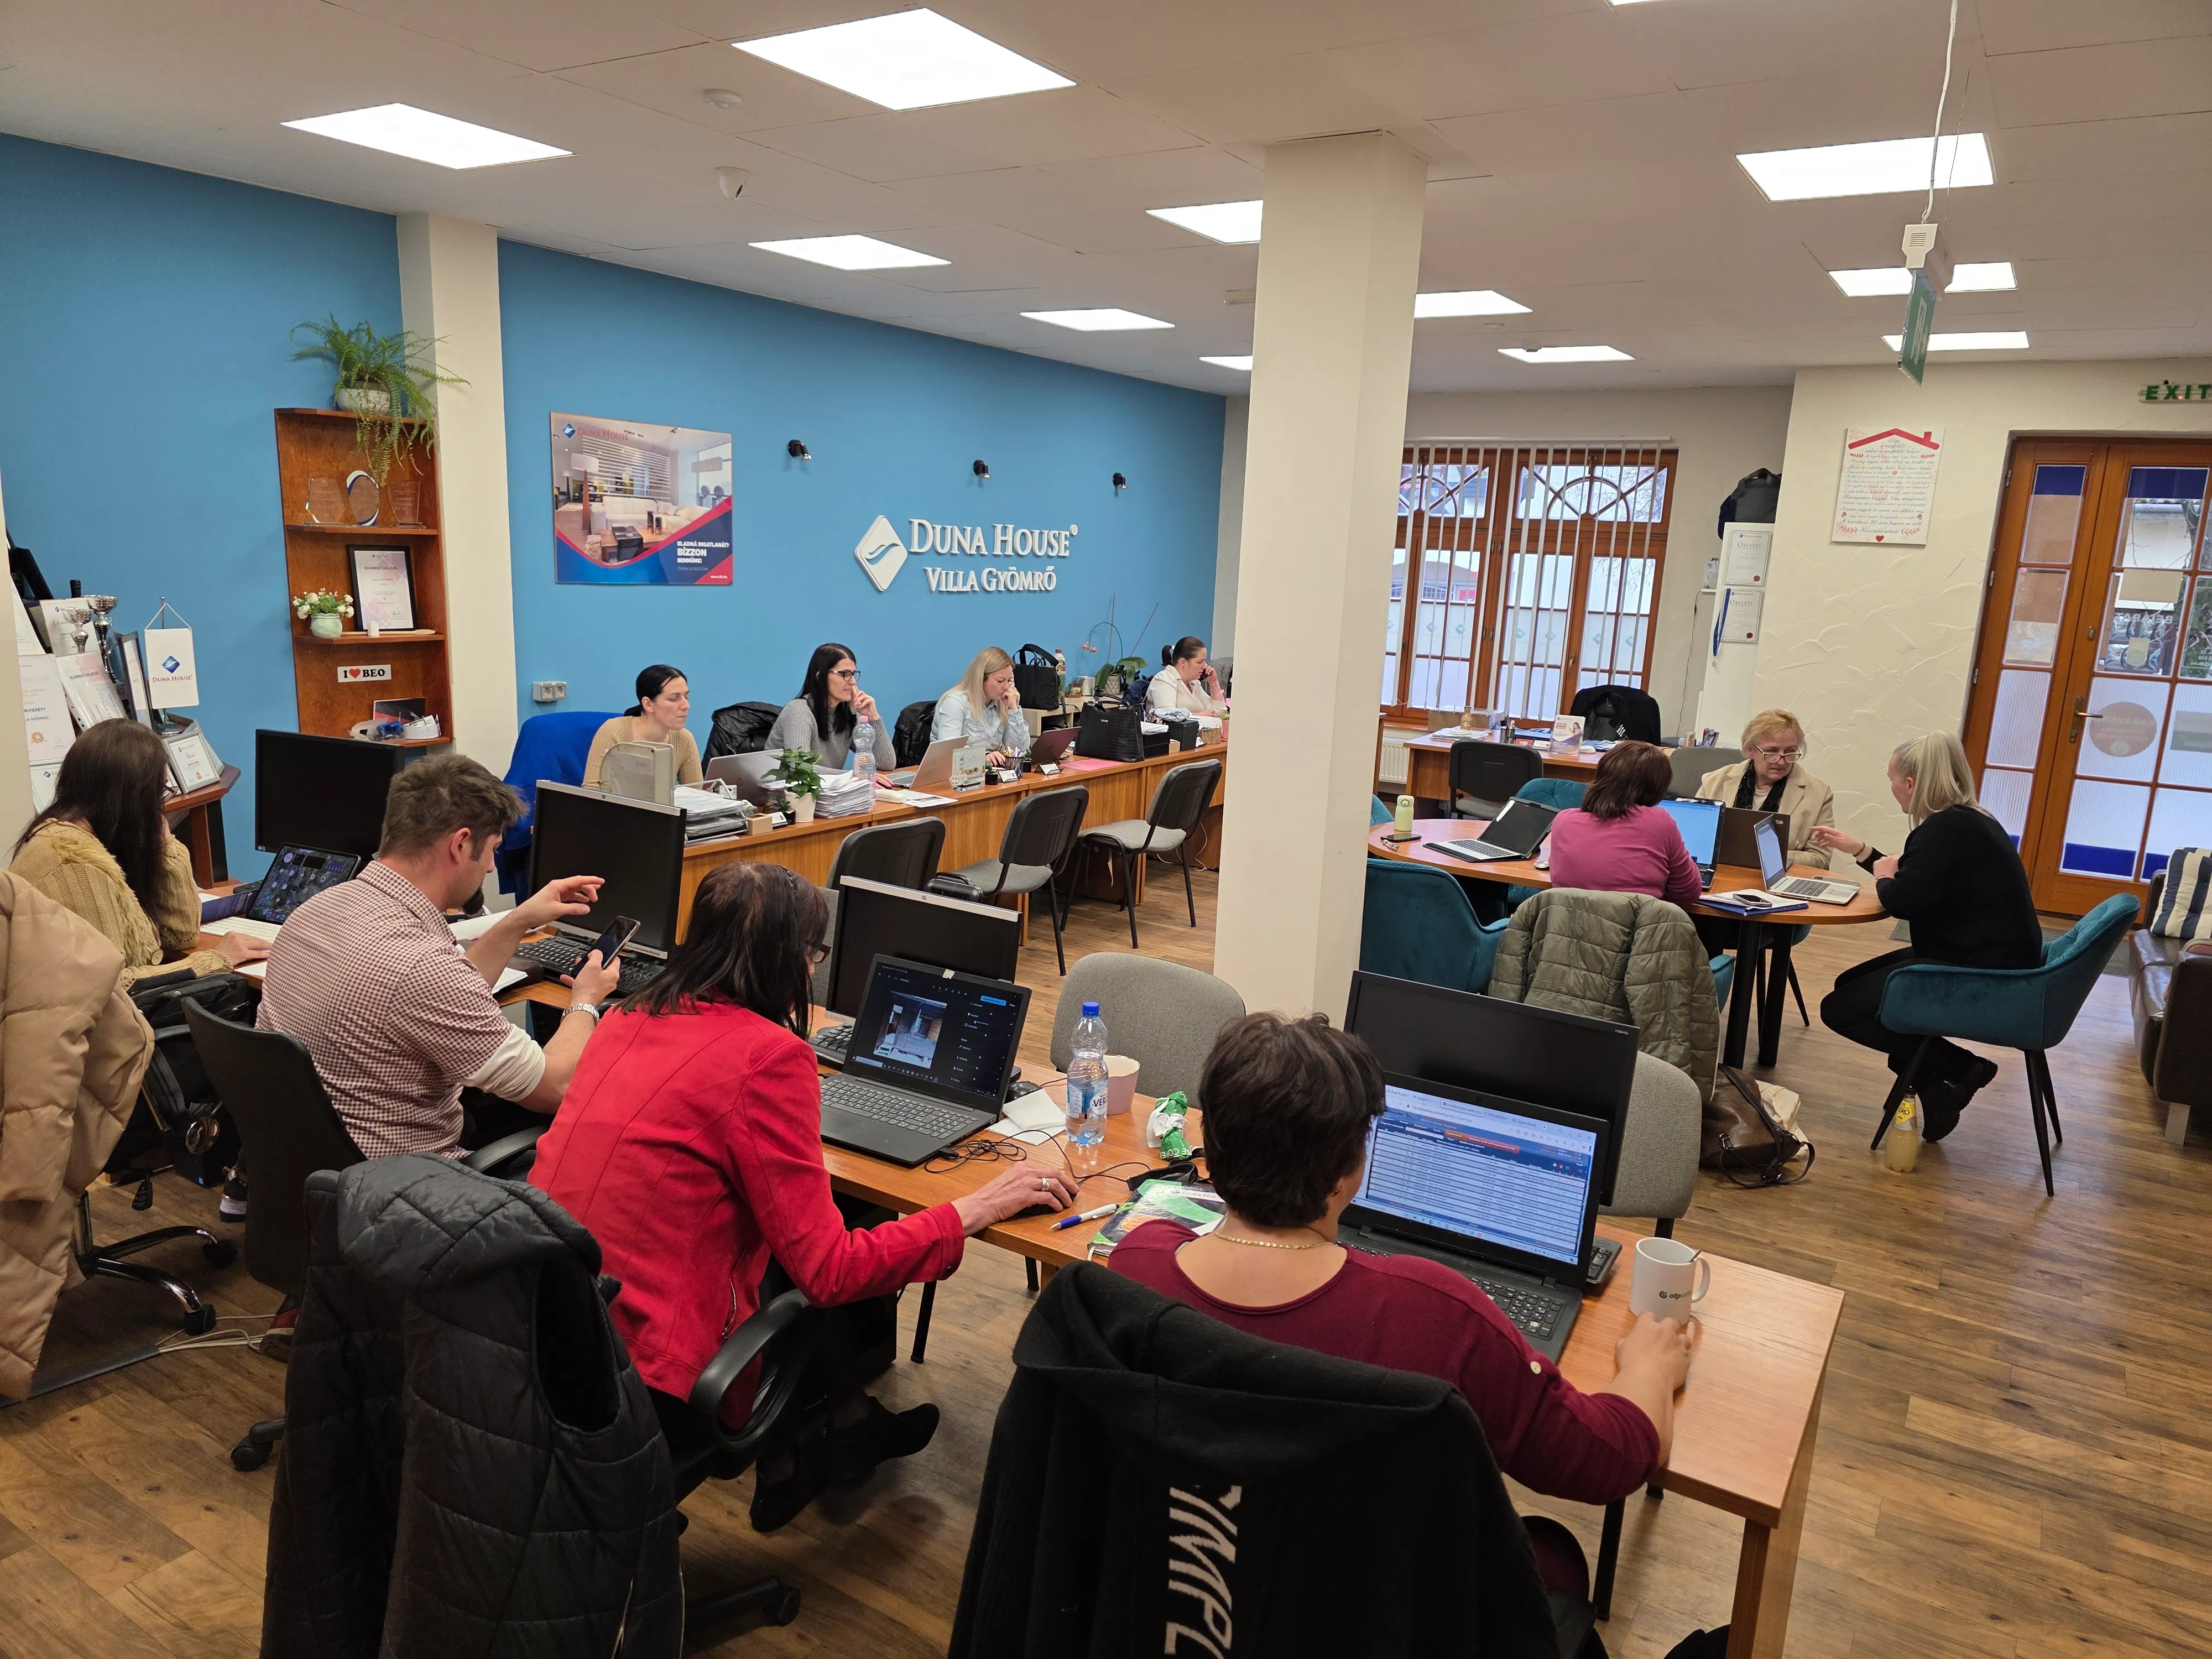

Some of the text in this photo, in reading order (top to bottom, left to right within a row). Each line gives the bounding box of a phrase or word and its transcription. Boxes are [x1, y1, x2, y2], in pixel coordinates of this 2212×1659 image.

[2146, 385, 2211, 400] EXIT
[578, 427, 629, 440] DUNA HOUSE
[909, 518, 989, 555] DUNA
[677, 547, 707, 556] BÍZZON
[924, 566, 1057, 592] VILLA GYÖMRŐ
[343, 669, 385, 678] I BEO
[1898, 1107, 1910, 1115] ERO
